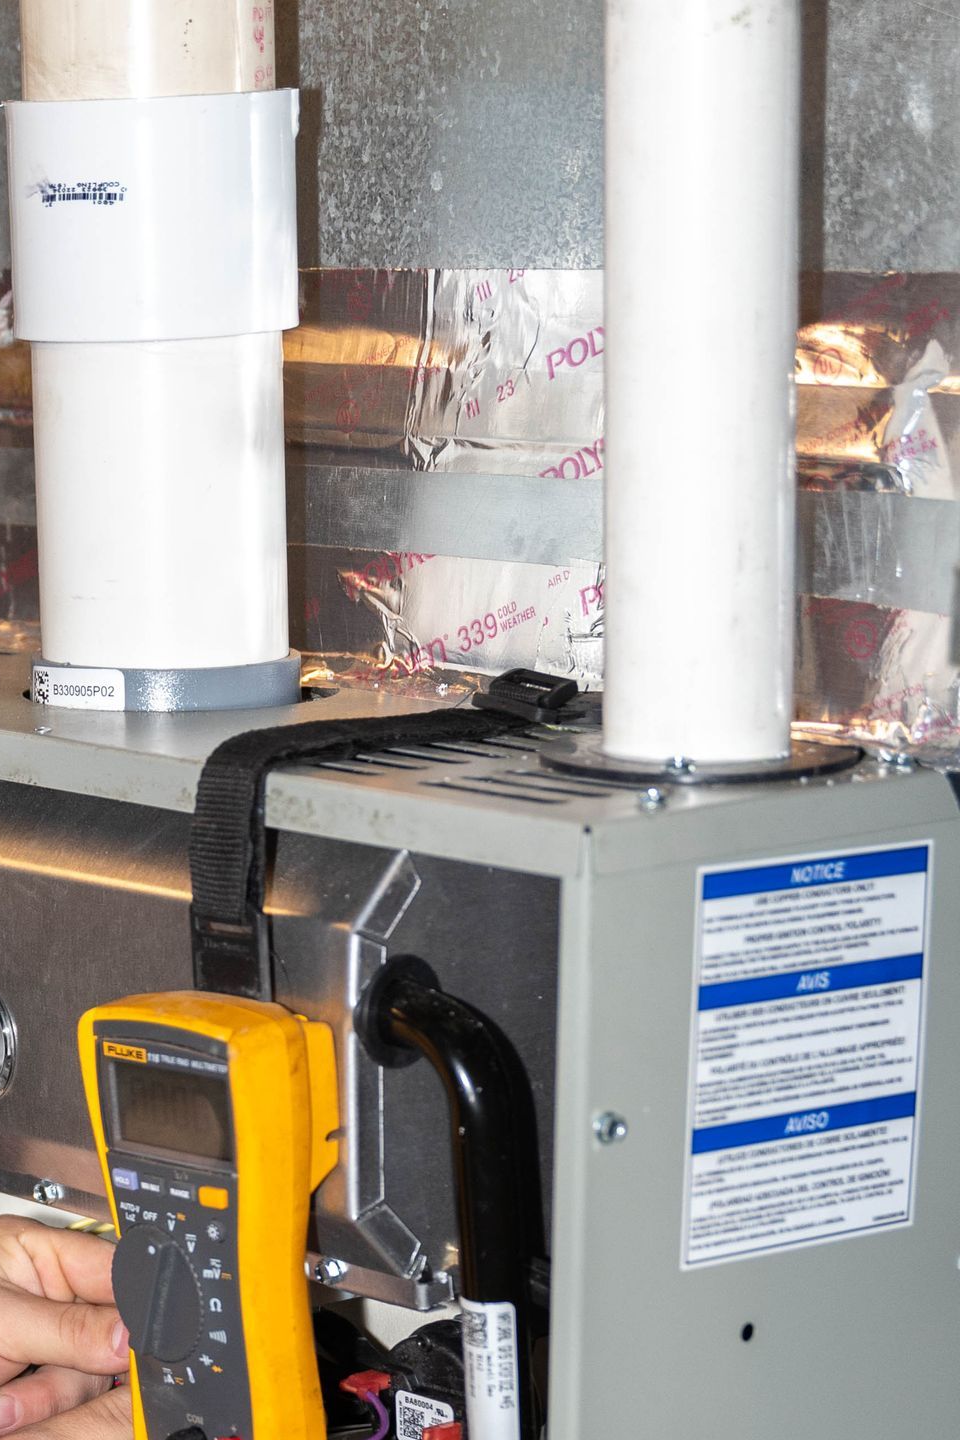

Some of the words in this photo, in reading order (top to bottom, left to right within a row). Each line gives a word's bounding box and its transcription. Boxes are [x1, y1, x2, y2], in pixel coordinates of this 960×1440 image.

[496, 380, 515, 403] 23
[548, 575, 562, 589] AIR
[457, 611, 499, 654] 339
[498, 600, 517, 620] COLD
[500, 606, 537, 633] WEATHER
[53, 684, 115, 698] B330905P02
[791, 862, 845, 884] NOTICE
[797, 972, 830, 992] AVIS
[107, 1045, 143, 1060] FLUKE
[785, 1111, 830, 1134] AVISO
[169, 1188, 191, 1200] RANGE
[120, 1201, 141, 1213] AUTO-V
[143, 1211, 158, 1222] OFF
